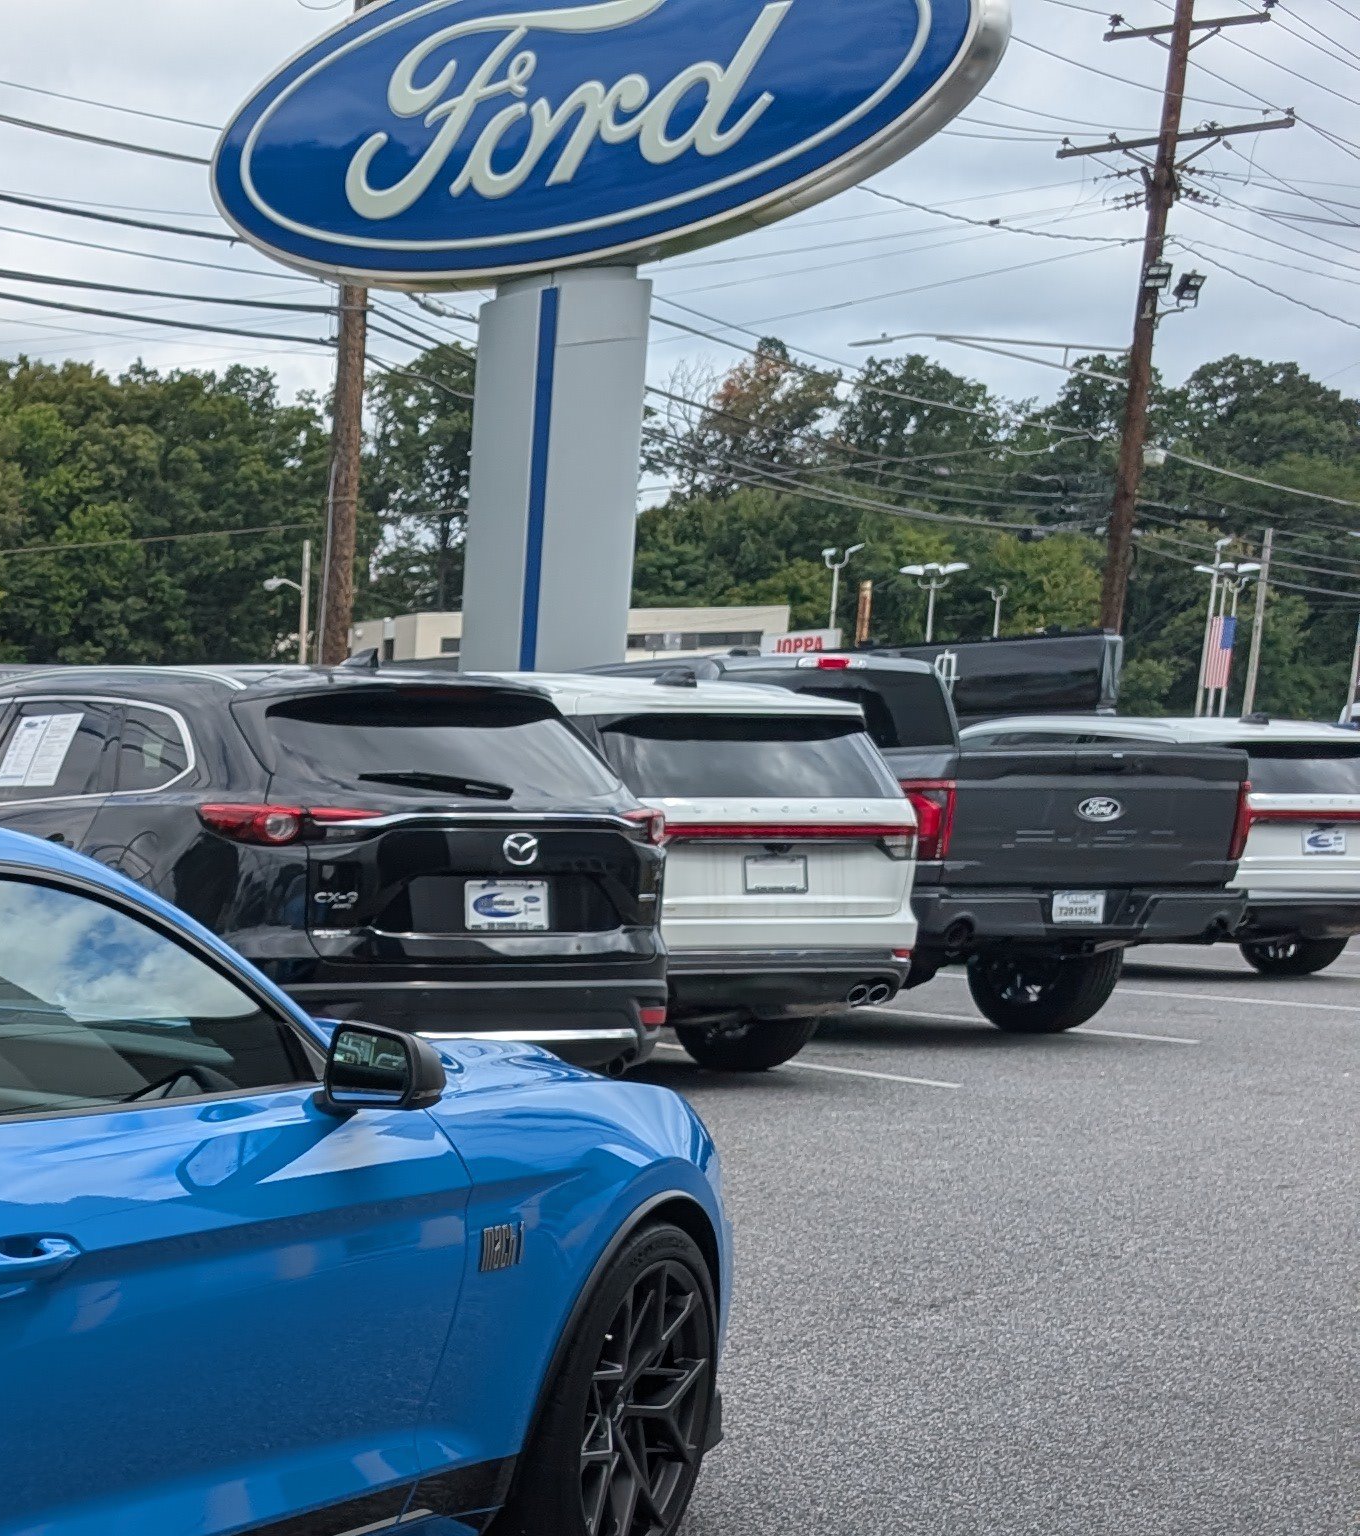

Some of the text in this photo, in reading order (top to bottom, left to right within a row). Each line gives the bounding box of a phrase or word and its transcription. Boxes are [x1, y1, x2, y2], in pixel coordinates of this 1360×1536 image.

[345, 0, 791, 219] Ford
[1084, 799, 1115, 817] Ford
[313, 891, 359, 904] CX-9
